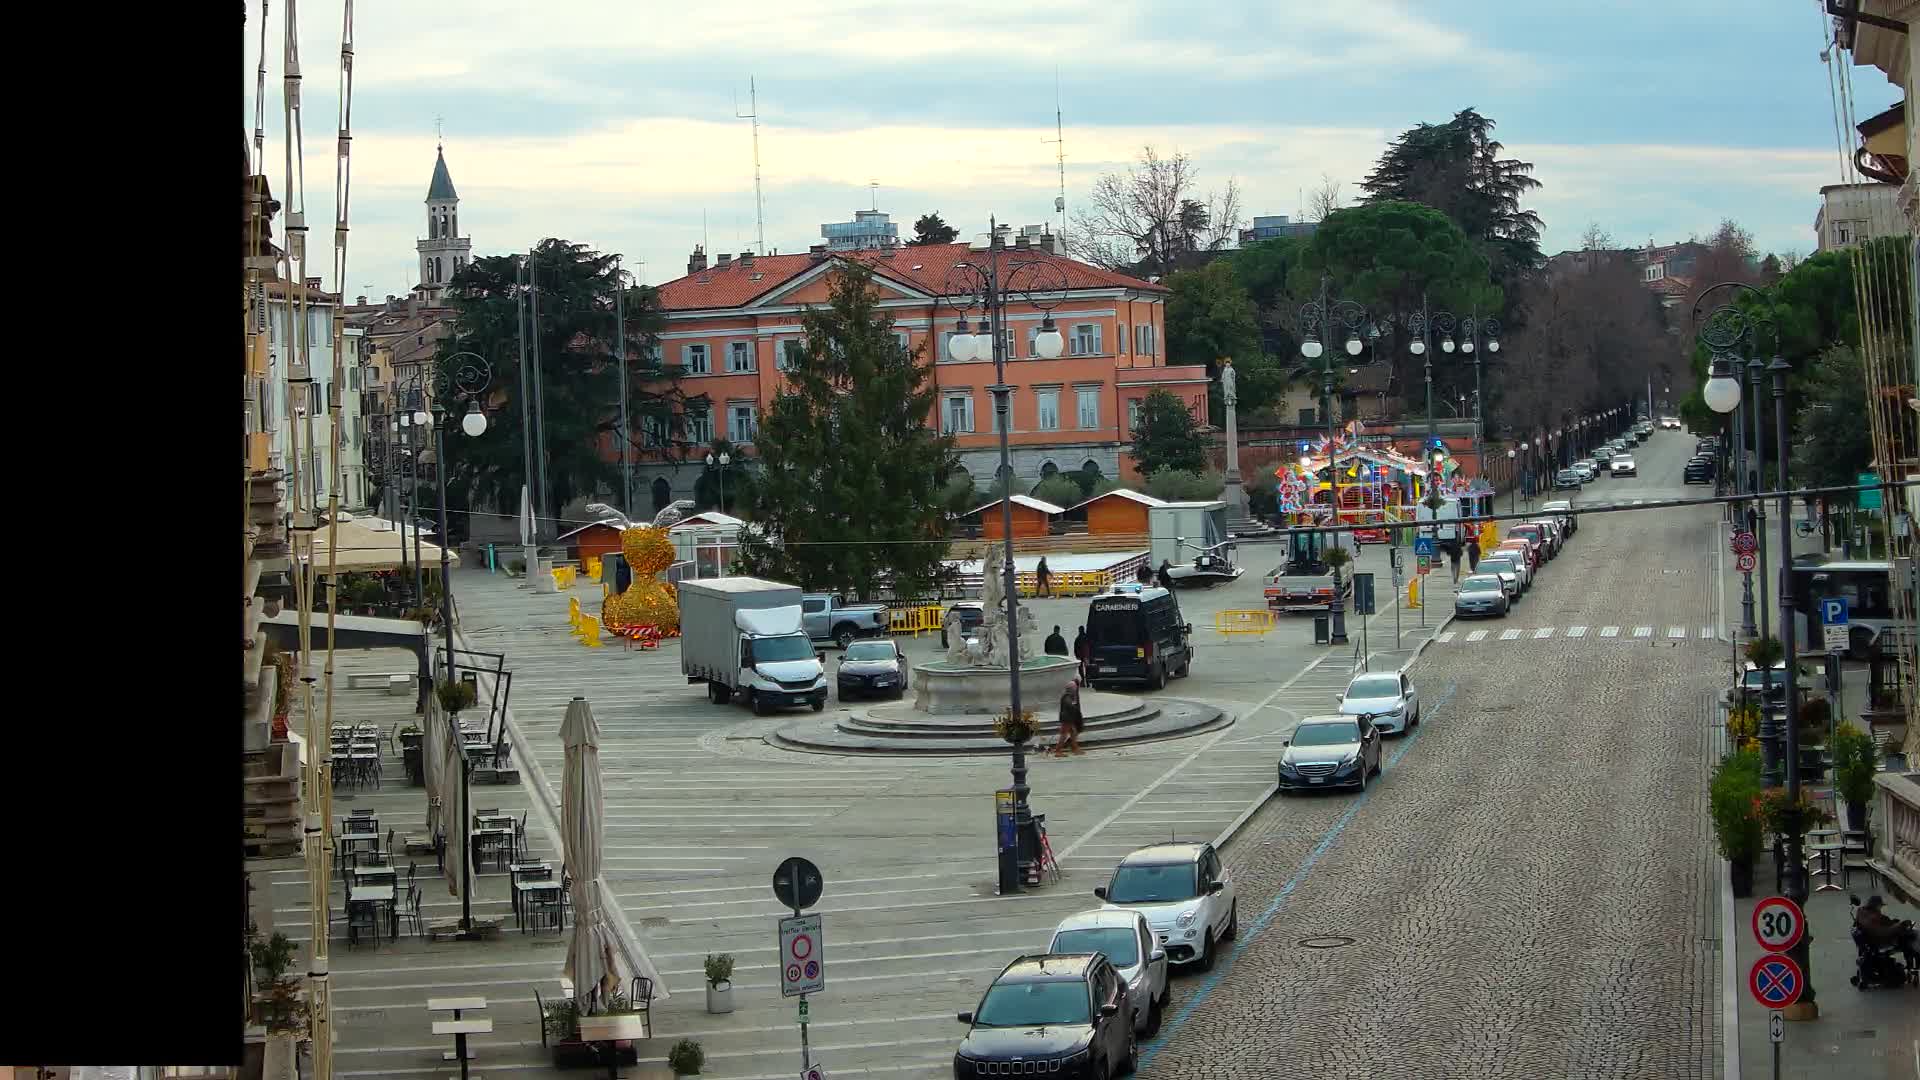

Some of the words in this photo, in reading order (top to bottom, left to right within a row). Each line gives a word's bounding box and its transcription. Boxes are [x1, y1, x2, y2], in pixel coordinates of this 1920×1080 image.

[1096, 603, 1139, 611] CARABINIERI
[1827, 602, 1842, 622] P
[1762, 911, 1792, 938] 30
